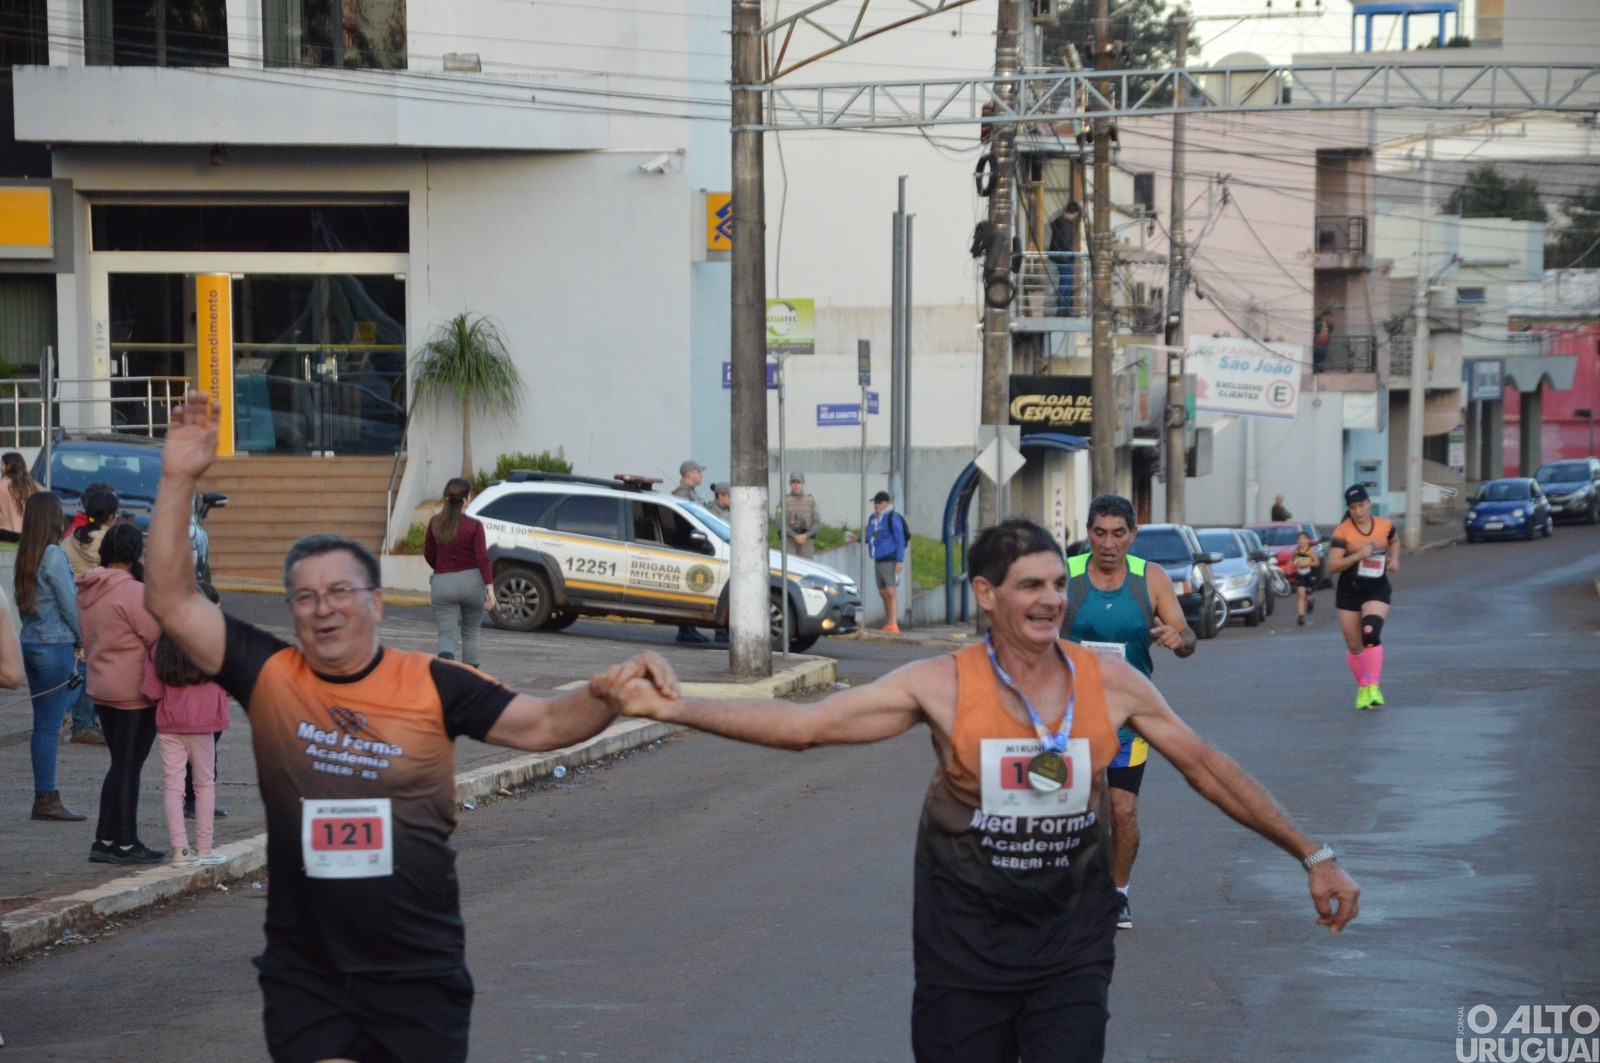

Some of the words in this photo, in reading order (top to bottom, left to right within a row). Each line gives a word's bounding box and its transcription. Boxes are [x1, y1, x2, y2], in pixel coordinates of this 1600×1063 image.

[1219, 355, 1250, 371] São
[1254, 358, 1294, 375] João
[1216, 381, 1263, 392] EXCLUSIVO
[1218, 391, 1260, 400] CLIENTES
[1273, 385, 1287, 403] E
[1040, 394, 1073, 406] LOJA
[511, 526, 527, 535] 190
[565, 556, 617, 577] 12251
[631, 560, 681, 574] BRIGADA
[630, 570, 680, 583] MILITAR
[298, 720, 339, 746] Med
[342, 733, 404, 757] Forma
[305, 743, 390, 769] Academia
[970, 808, 1018, 834] Med
[323, 822, 373, 845] 121
[982, 836, 1081, 854] Academia
[991, 855, 1043, 871] SEBERI
